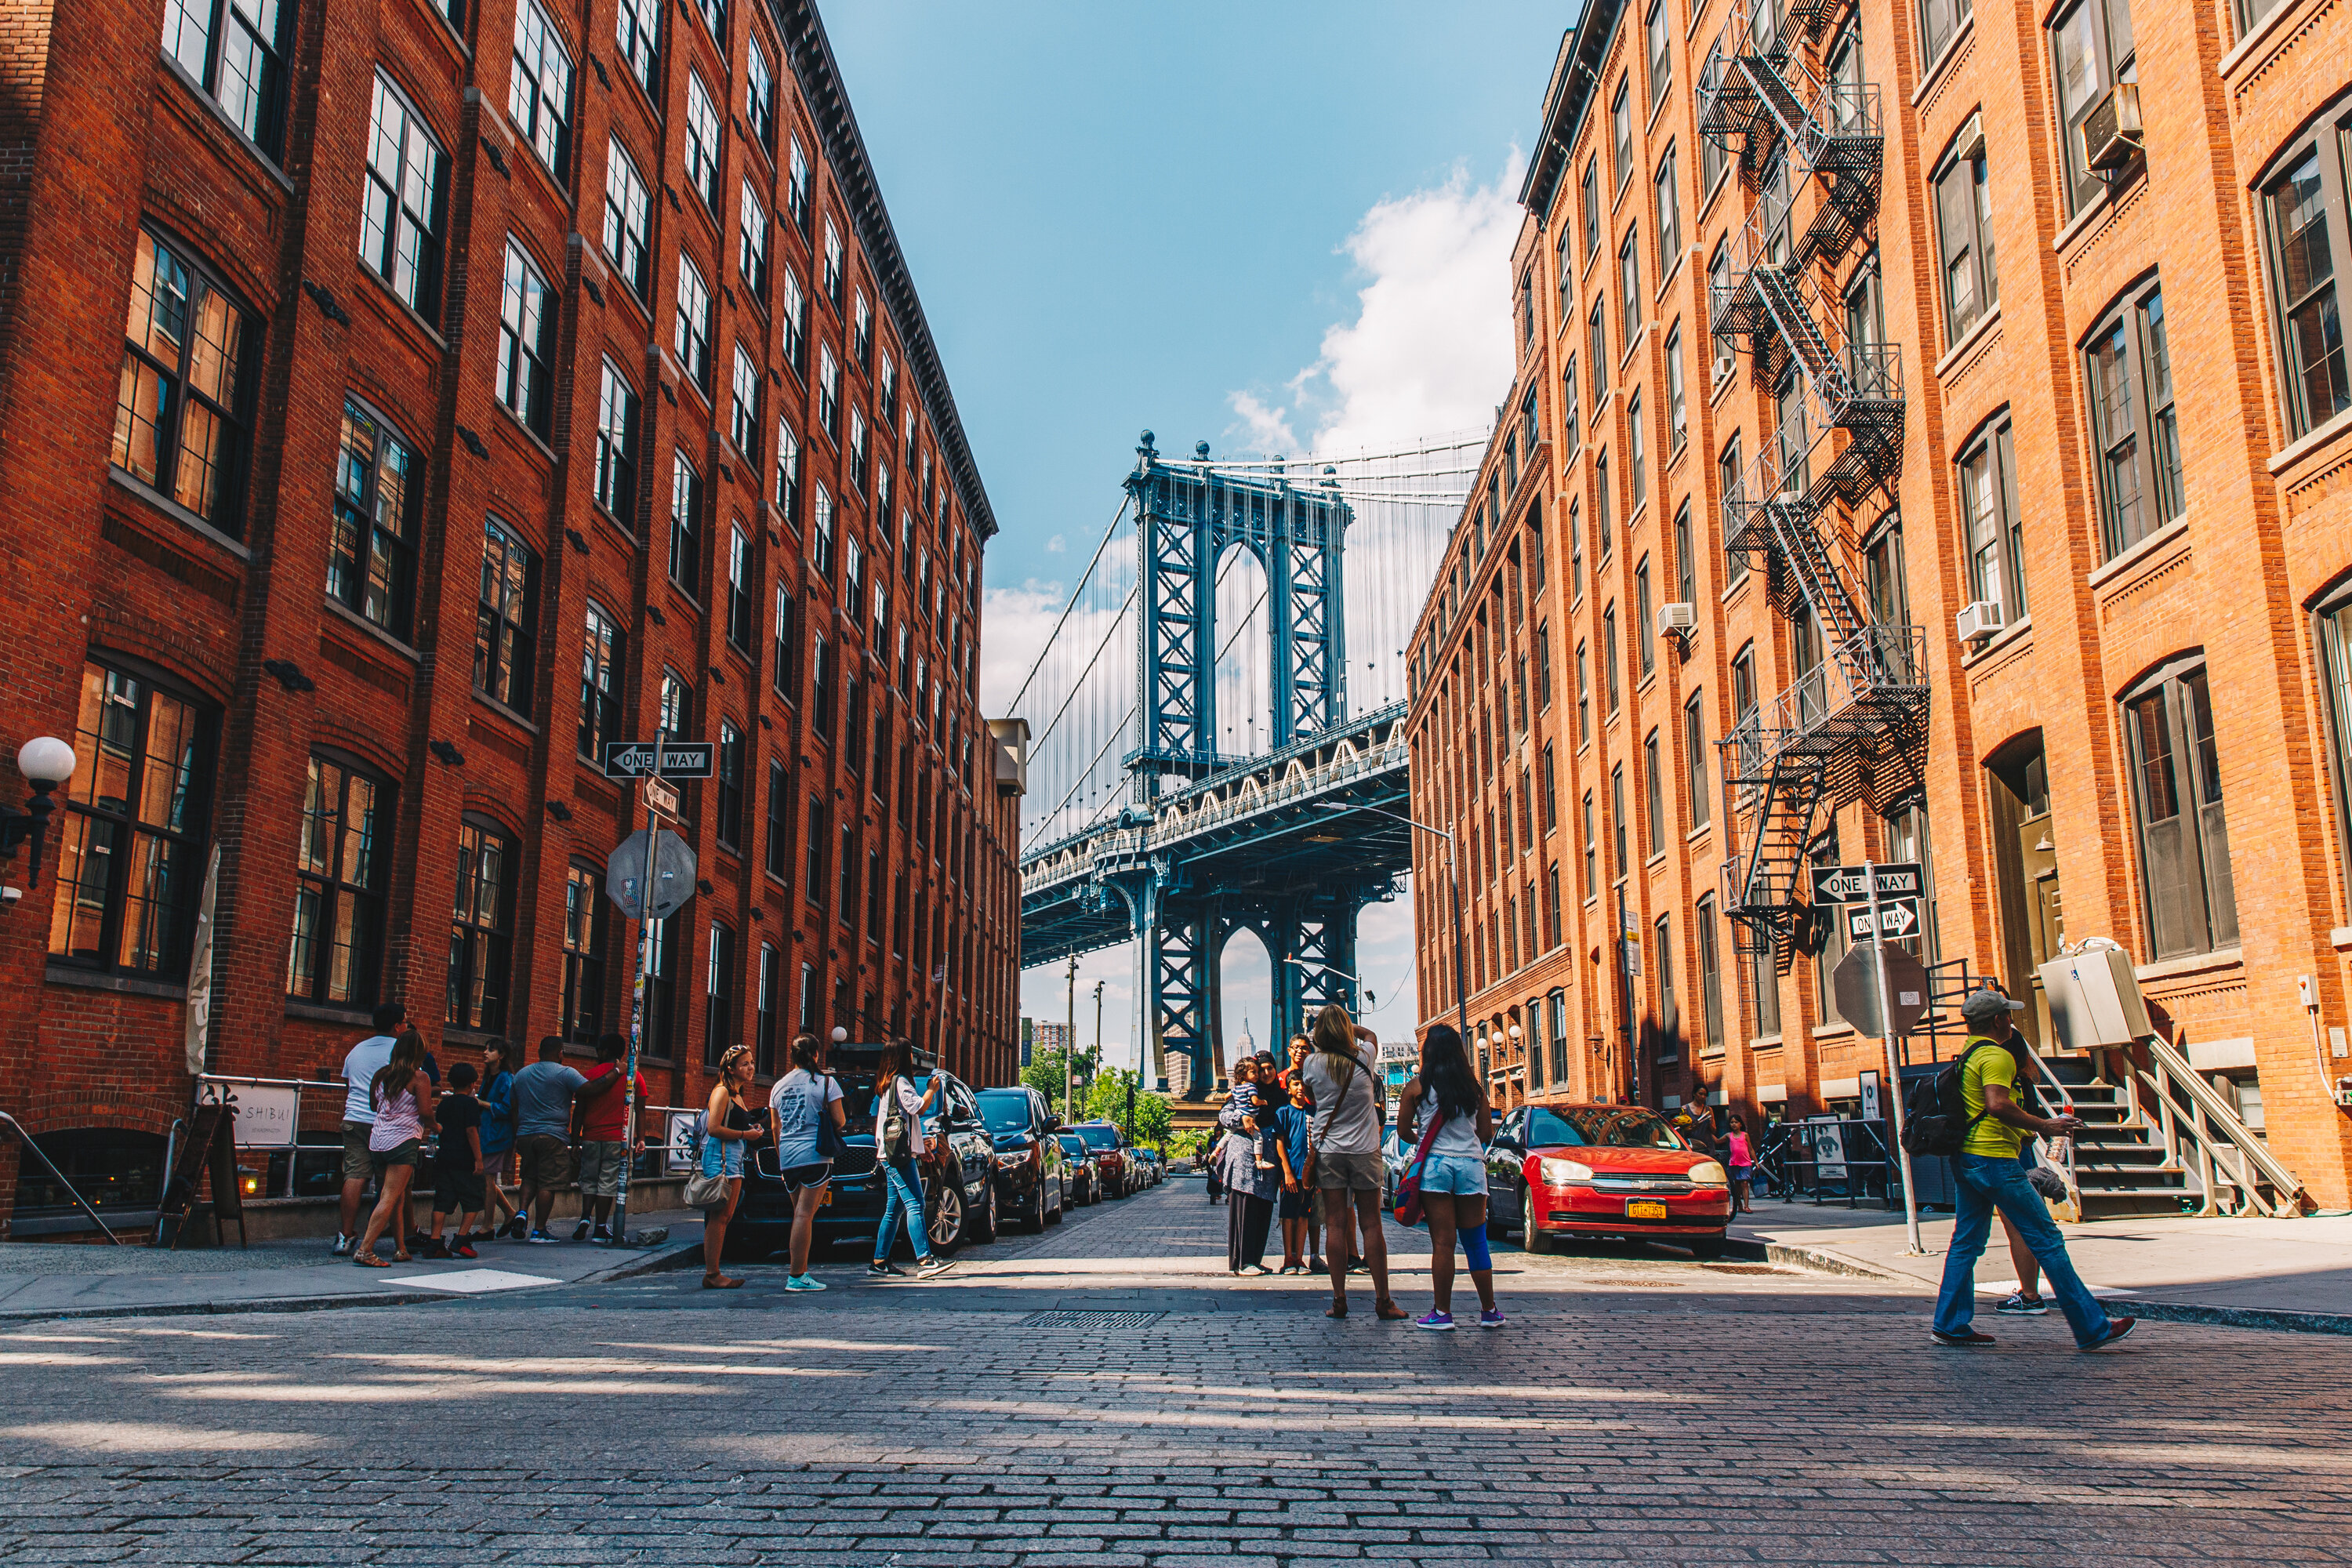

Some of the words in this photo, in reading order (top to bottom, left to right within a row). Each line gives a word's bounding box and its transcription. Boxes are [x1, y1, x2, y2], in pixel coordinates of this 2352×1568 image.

[622, 753, 653, 767] ONE
[666, 753, 699, 767] WAY
[649, 783, 659, 801] ONE
[663, 793, 676, 811] WAY
[1830, 877, 1862, 892] ONE
[1876, 875, 1908, 890] WAY
[1857, 917, 1872, 931] ON
[1885, 911, 1907, 927] WAY
[246, 1106, 289, 1121] SHIBUI
